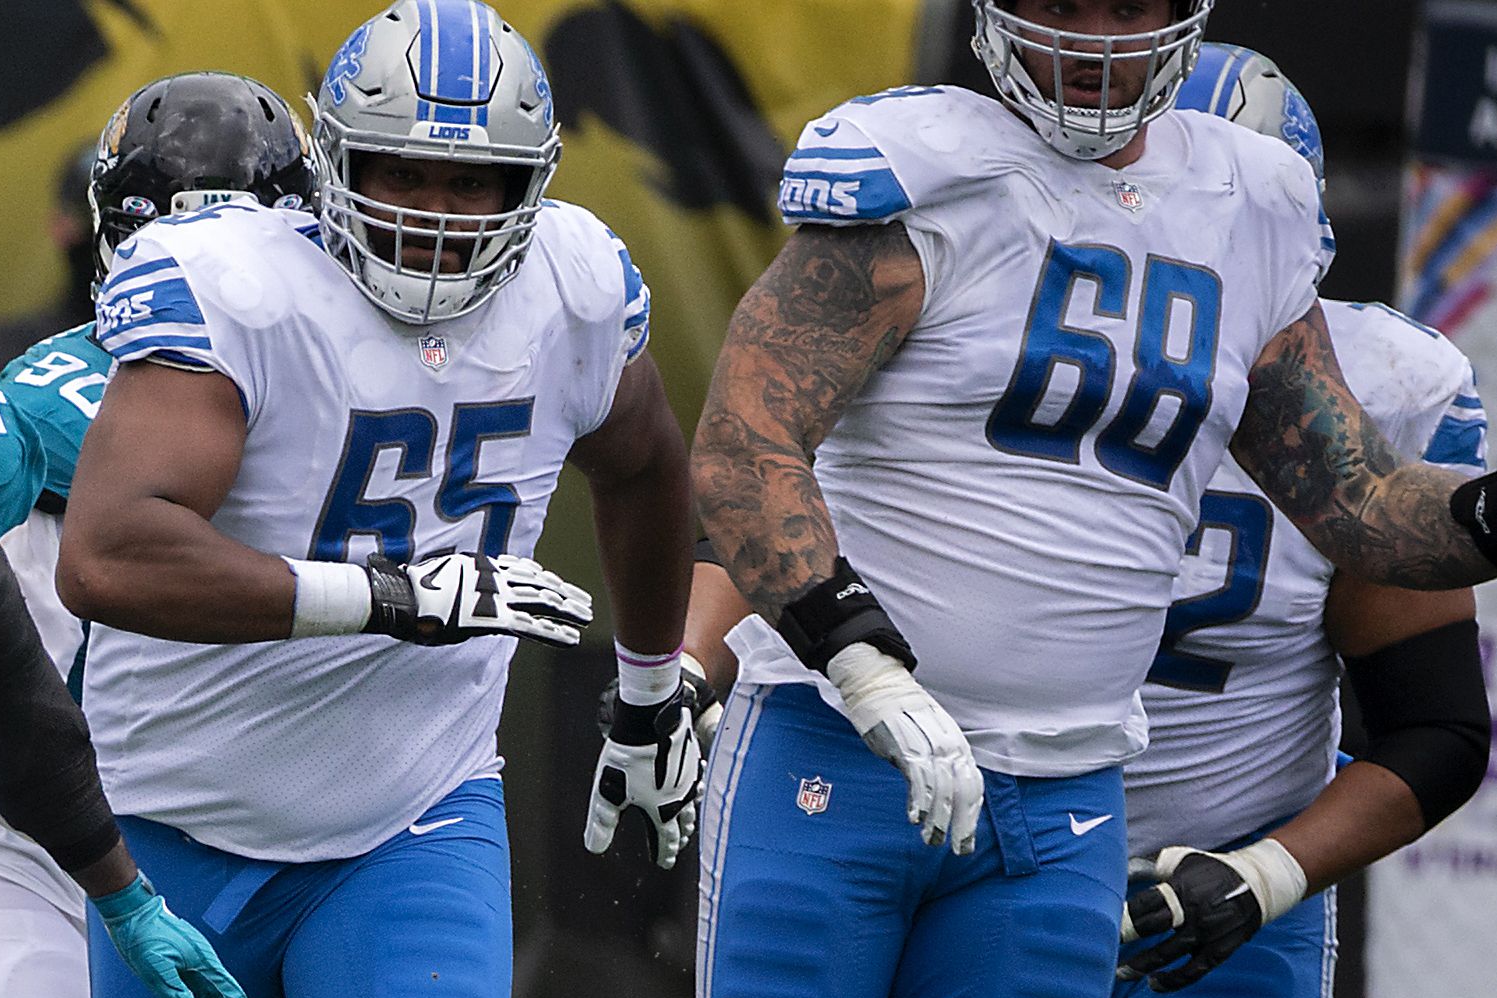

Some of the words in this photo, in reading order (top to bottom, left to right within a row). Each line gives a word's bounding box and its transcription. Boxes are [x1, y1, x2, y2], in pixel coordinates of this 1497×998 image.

[429, 125, 471, 140] LIONS
[777, 178, 861, 216] IONS
[985, 235, 1223, 491] 68
[307, 395, 536, 564] 65
[1145, 489, 1274, 694] 2
